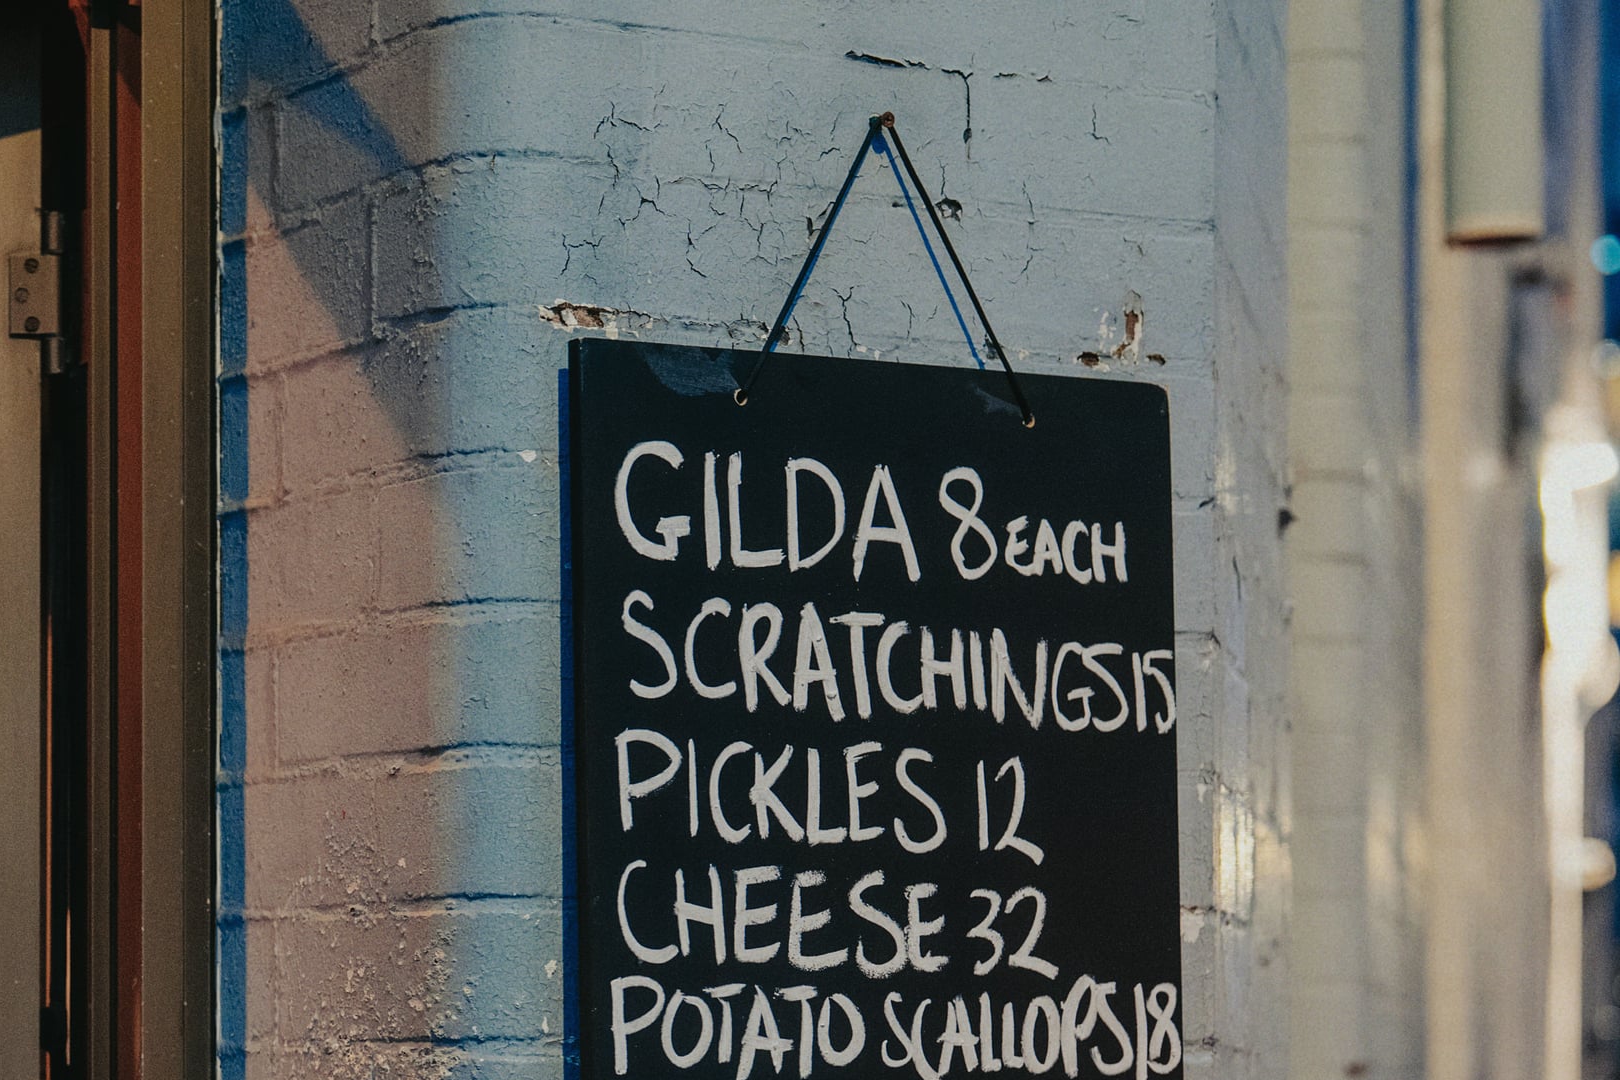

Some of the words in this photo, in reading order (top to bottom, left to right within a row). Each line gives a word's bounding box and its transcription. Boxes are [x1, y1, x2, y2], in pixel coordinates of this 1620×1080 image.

[615, 441, 920, 582] GILDA
[1005, 516, 1127, 584] EACH
[622, 590, 1128, 731] SCRATCHINGS
[1133, 648, 1177, 733] 15
[615, 728, 946, 853] PICKLES
[977, 757, 1044, 865] 12
[615, 860, 948, 980] CHEESE
[967, 887, 1059, 979] 32
